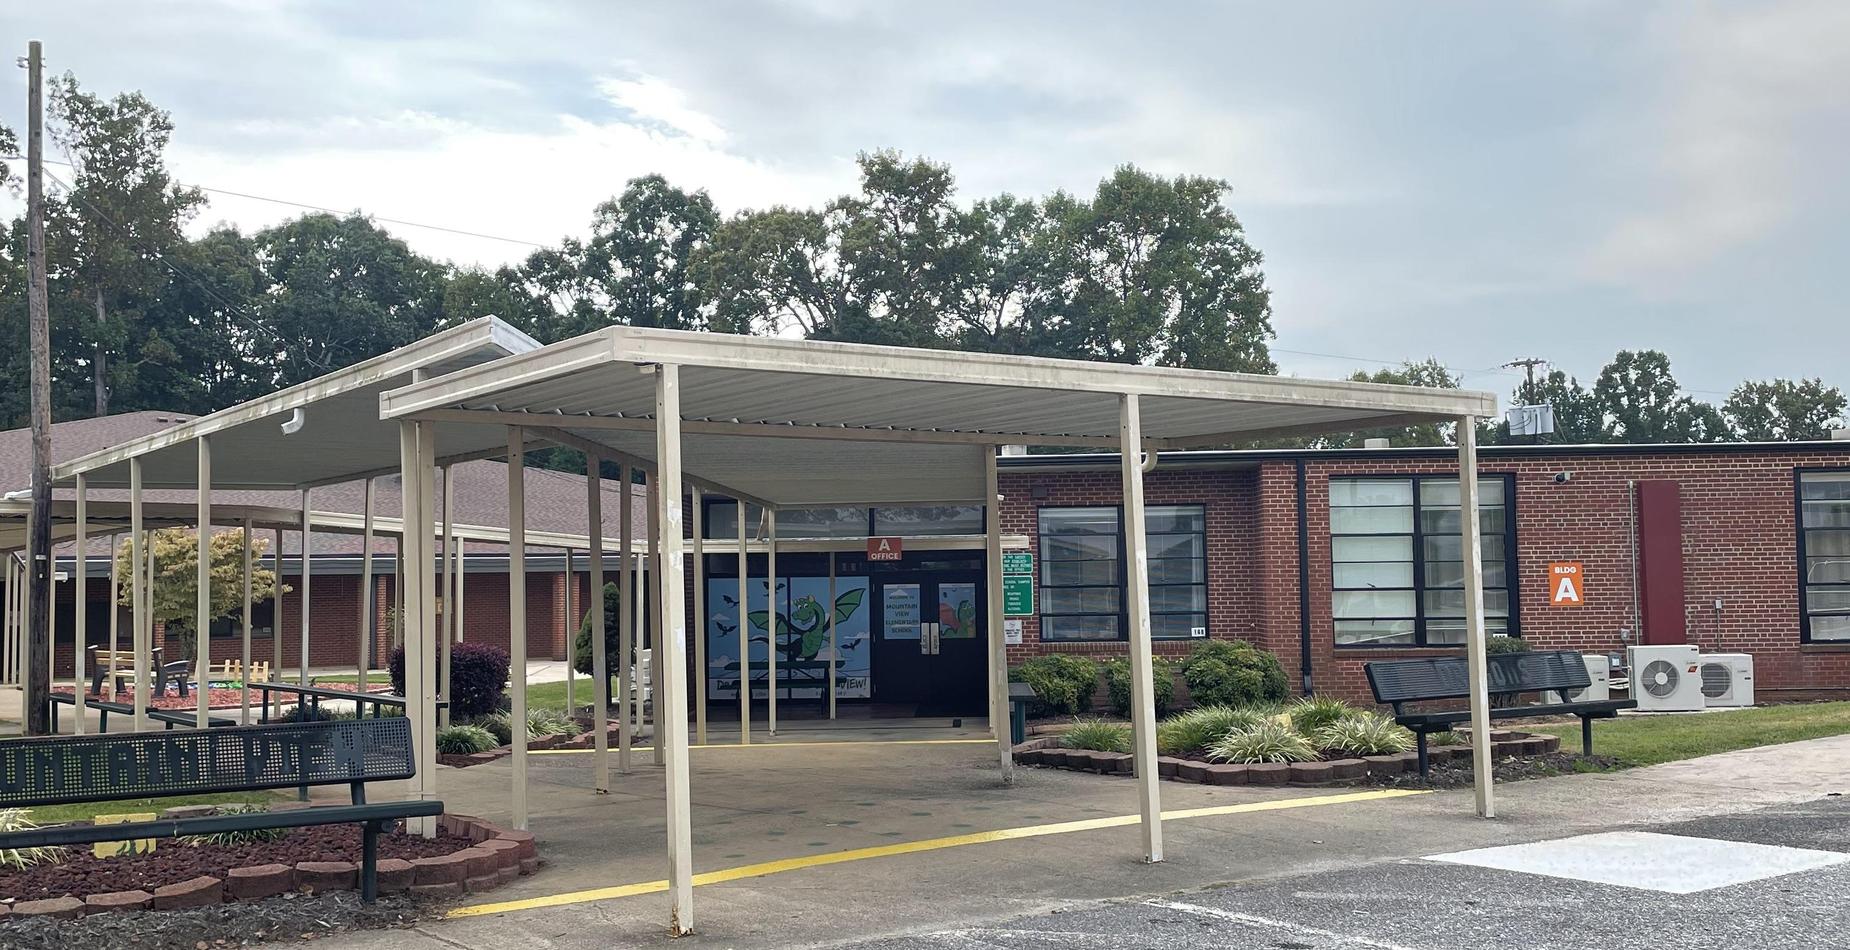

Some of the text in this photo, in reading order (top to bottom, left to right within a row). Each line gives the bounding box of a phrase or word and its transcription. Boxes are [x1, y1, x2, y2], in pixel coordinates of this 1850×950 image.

[879, 539, 890, 551] A
[871, 552, 899, 560] OFFICE
[1554, 566, 1577, 574] BLDG
[1554, 577, 1580, 602] A
